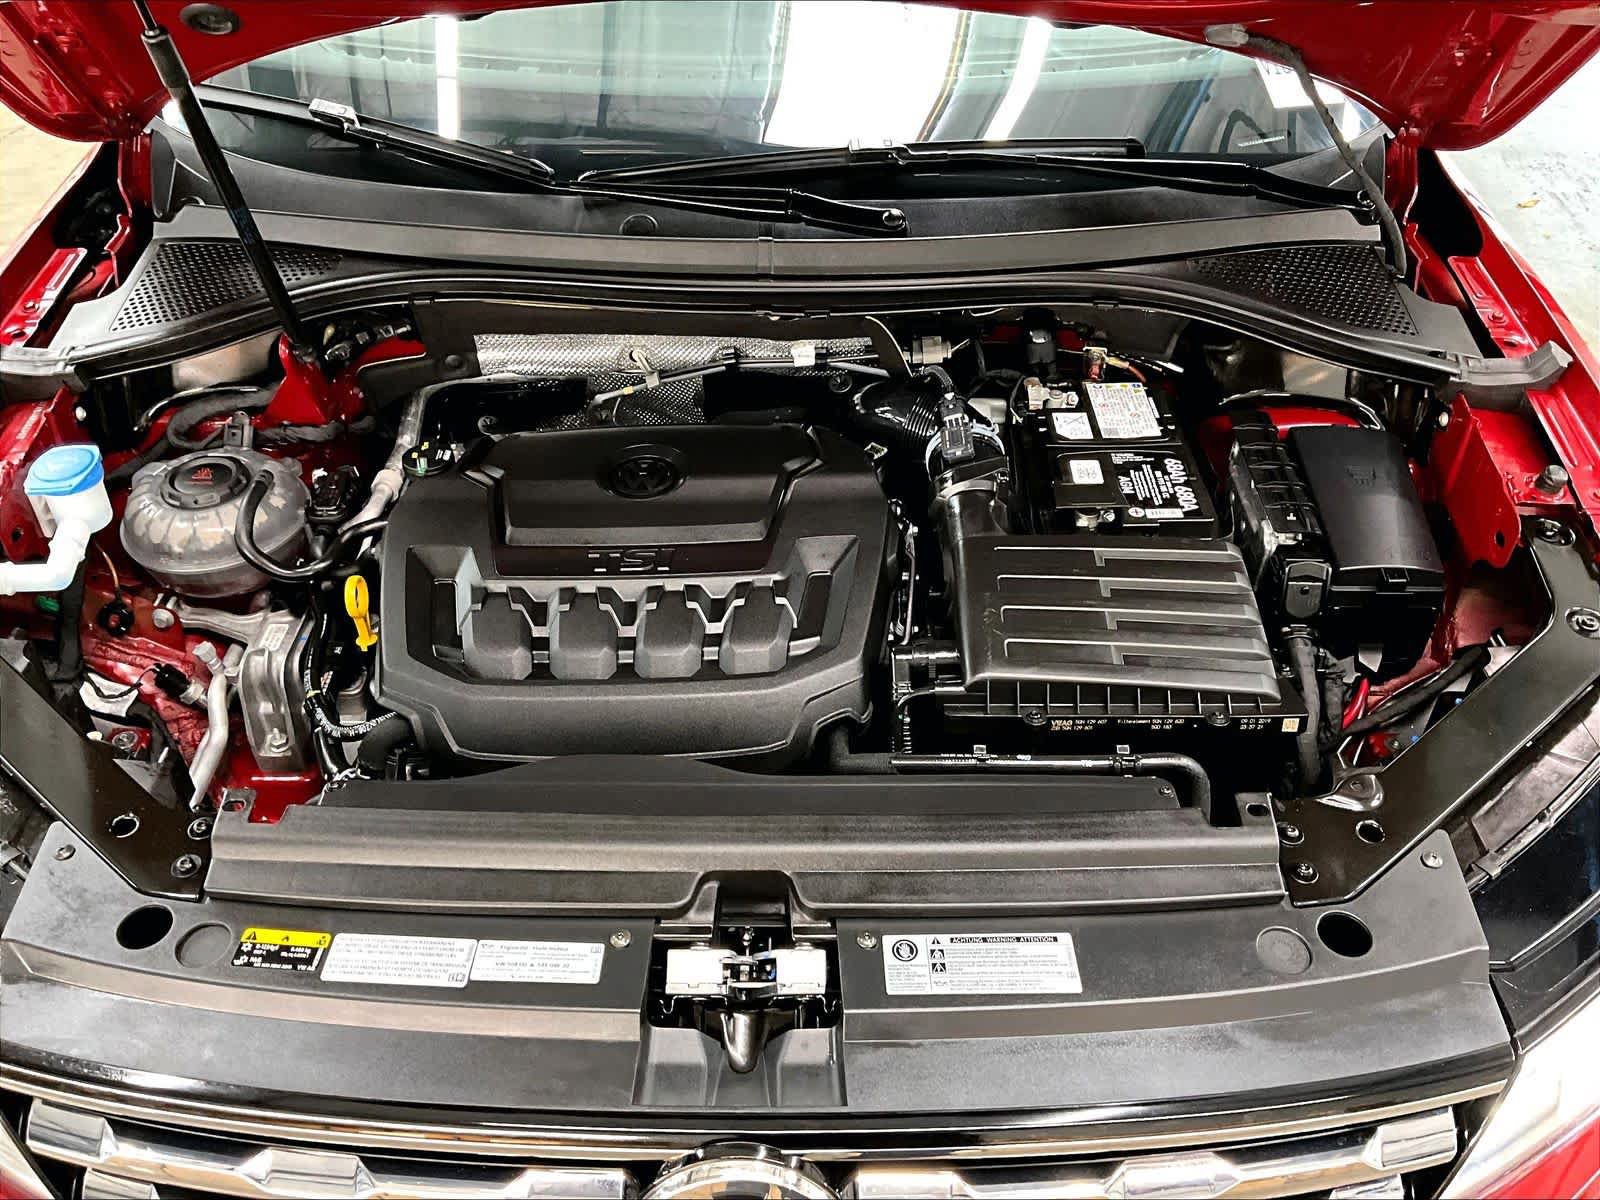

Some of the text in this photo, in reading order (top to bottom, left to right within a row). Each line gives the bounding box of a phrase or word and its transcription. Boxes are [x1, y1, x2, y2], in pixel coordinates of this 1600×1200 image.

[1164, 458, 1188, 484] 68Ah
[1117, 475, 1135, 495] AGM
[1174, 485, 1199, 512] 680A
[588, 548, 676, 572] TSI
[953, 935, 1054, 944] ACHTUNG WARNING ATTENTION
